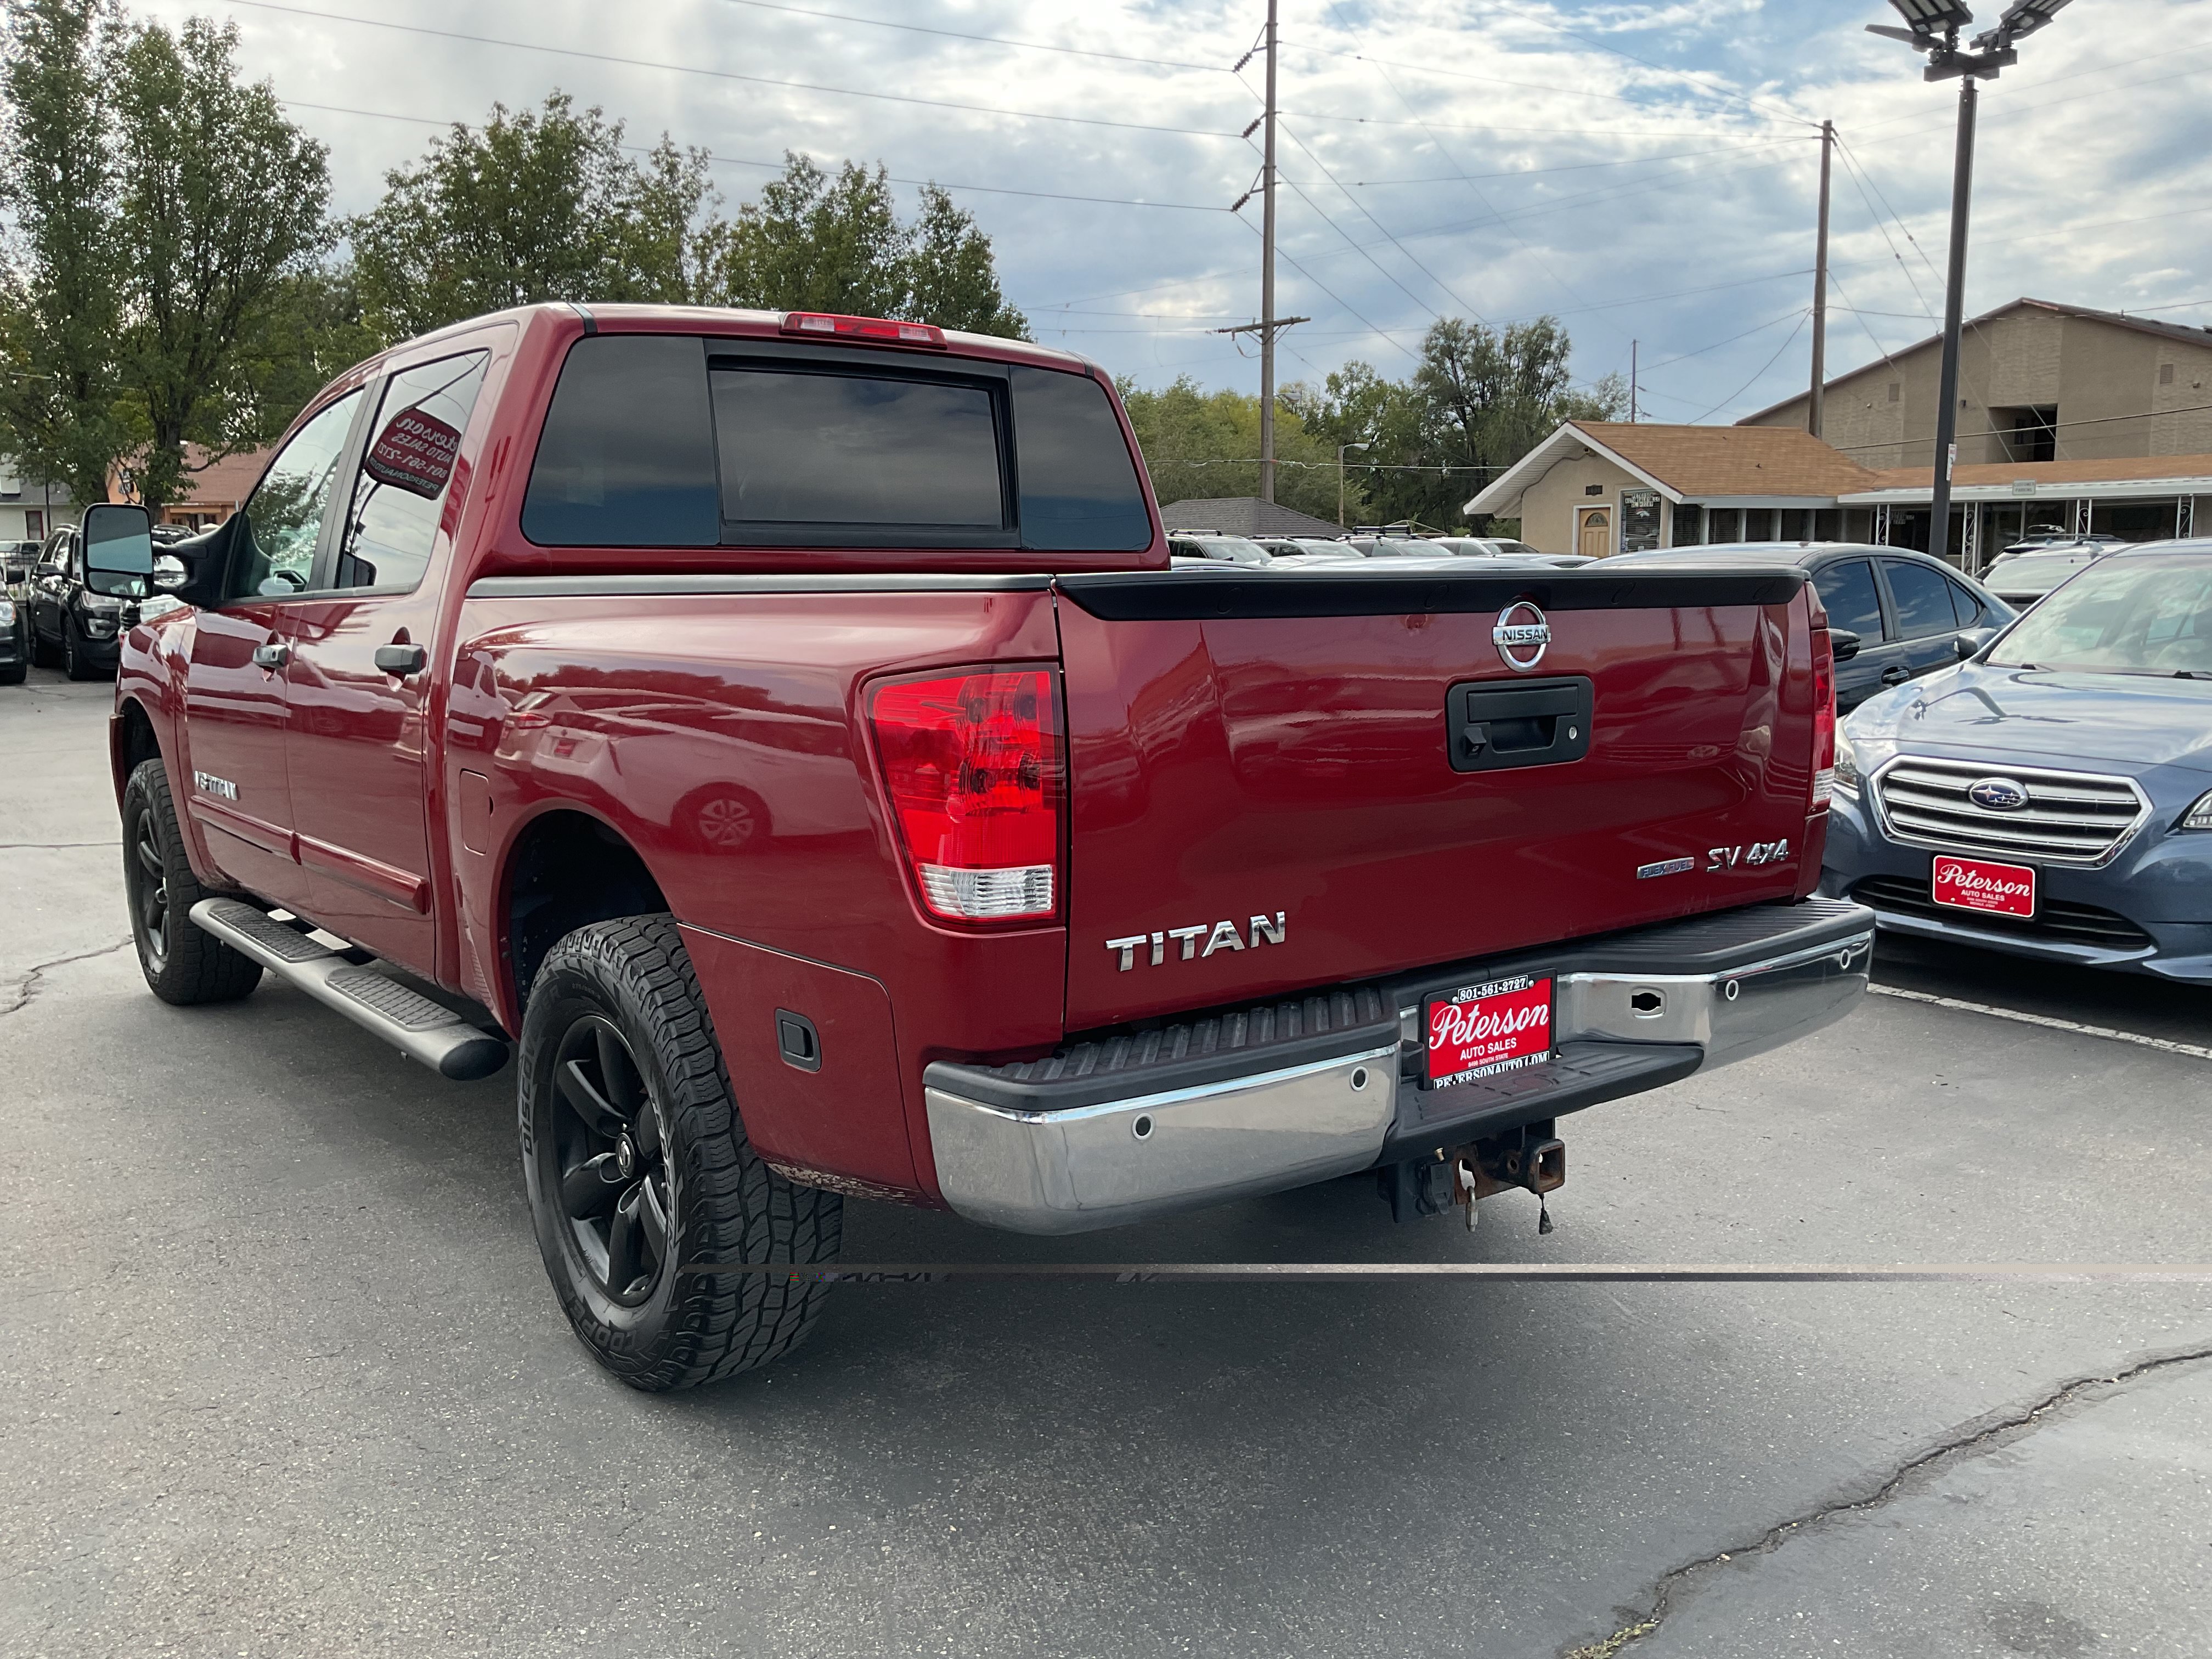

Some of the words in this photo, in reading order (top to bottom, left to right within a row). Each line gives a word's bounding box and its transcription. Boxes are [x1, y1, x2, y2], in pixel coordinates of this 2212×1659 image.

[1502, 629, 1548, 641] NISSAN
[1643, 864, 1667, 878] FLEX
[1669, 861, 1692, 873] FUEL
[1707, 845, 1741, 872] SV
[1937, 864, 2030, 897] Peterson
[1961, 889, 1980, 898] AUTO
[1982, 893, 2005, 901] SALES
[1105, 911, 1286, 972] TITAN
[1459, 977, 1526, 1001] 801-561-2727
[1429, 1003, 1549, 1050] Peterson
[1460, 1045, 1485, 1061] AUTO
[1487, 1037, 1517, 1054] SALES
[1479, 1056, 1494, 1065] SOUTH
[1495, 1052, 1509, 1061] STATE
